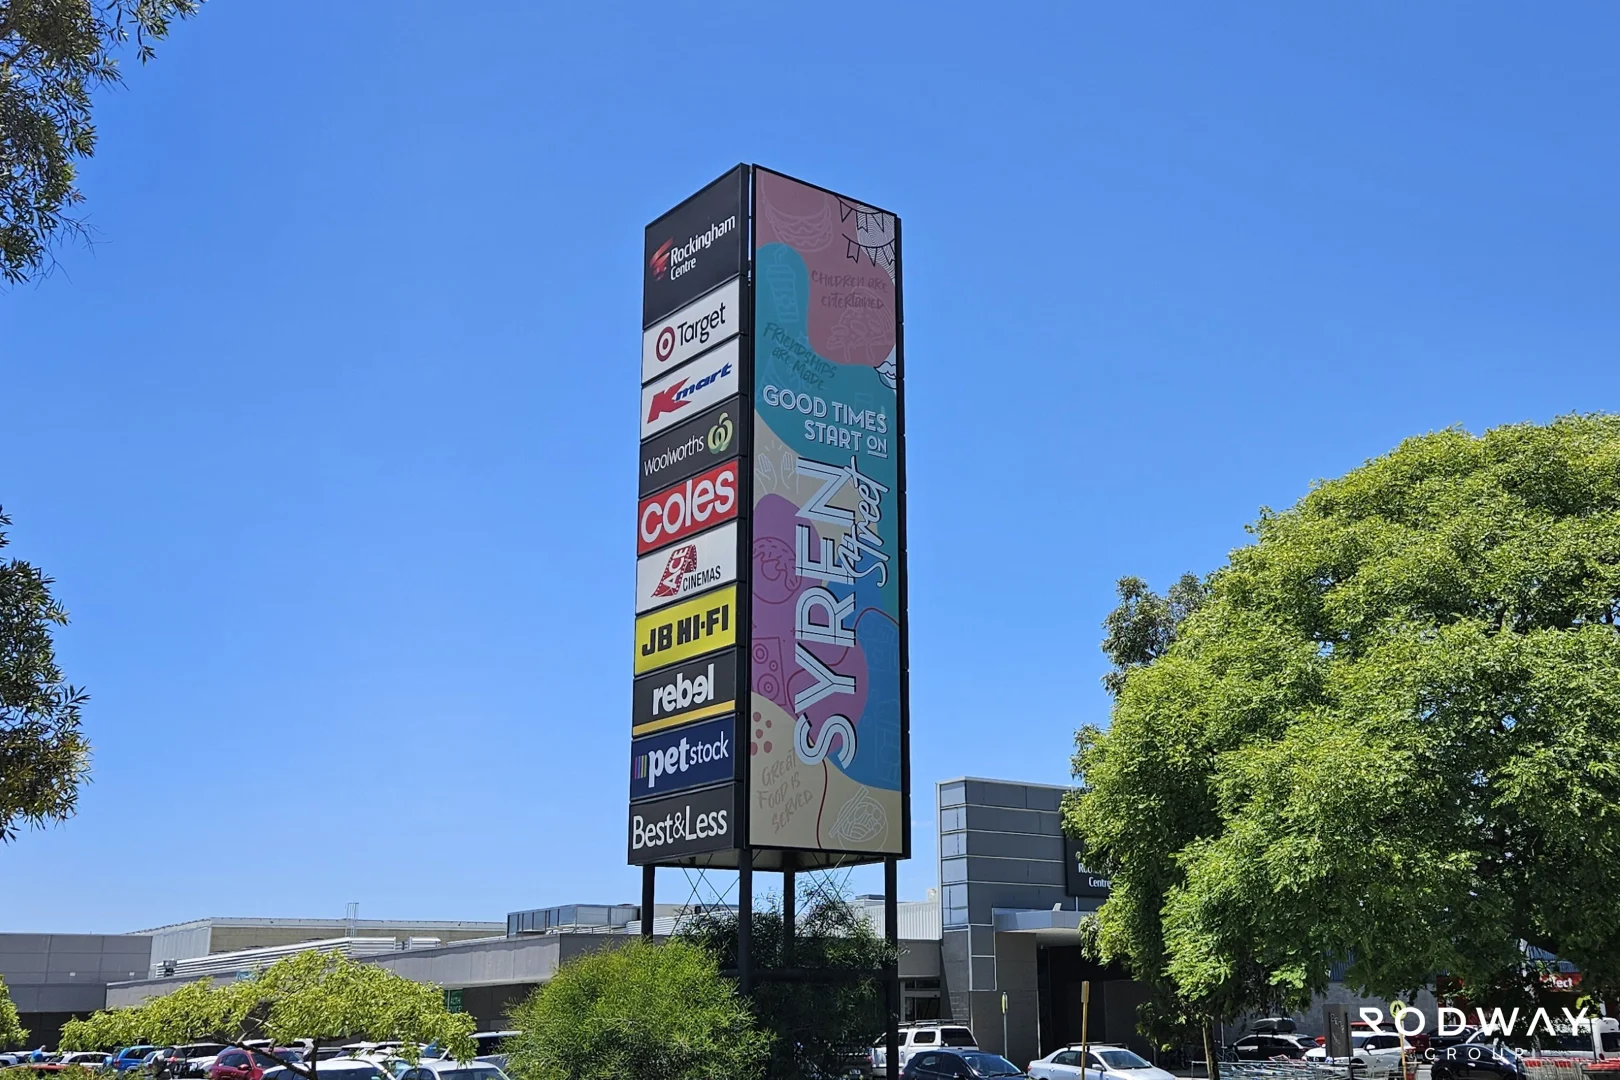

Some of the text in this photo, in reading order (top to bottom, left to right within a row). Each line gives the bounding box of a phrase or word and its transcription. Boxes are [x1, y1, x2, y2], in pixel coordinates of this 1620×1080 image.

[670, 215, 736, 267] Rockingham
[670, 257, 697, 281] Centre
[677, 302, 726, 346] Target
[647, 362, 732, 424] Kmart
[762, 384, 887, 434] GOOD TIMES
[643, 435, 705, 477] Woolworths
[804, 419, 888, 454] START ON
[640, 470, 735, 543] coles
[837, 455, 890, 588] Street
[662, 546, 689, 590] ACE
[682, 565, 722, 592] CINEMAS
[794, 456, 858, 770] SYREN
[641, 623, 673, 657] JB
[652, 663, 715, 716] rebel
[1088, 876, 1111, 888] Centre
